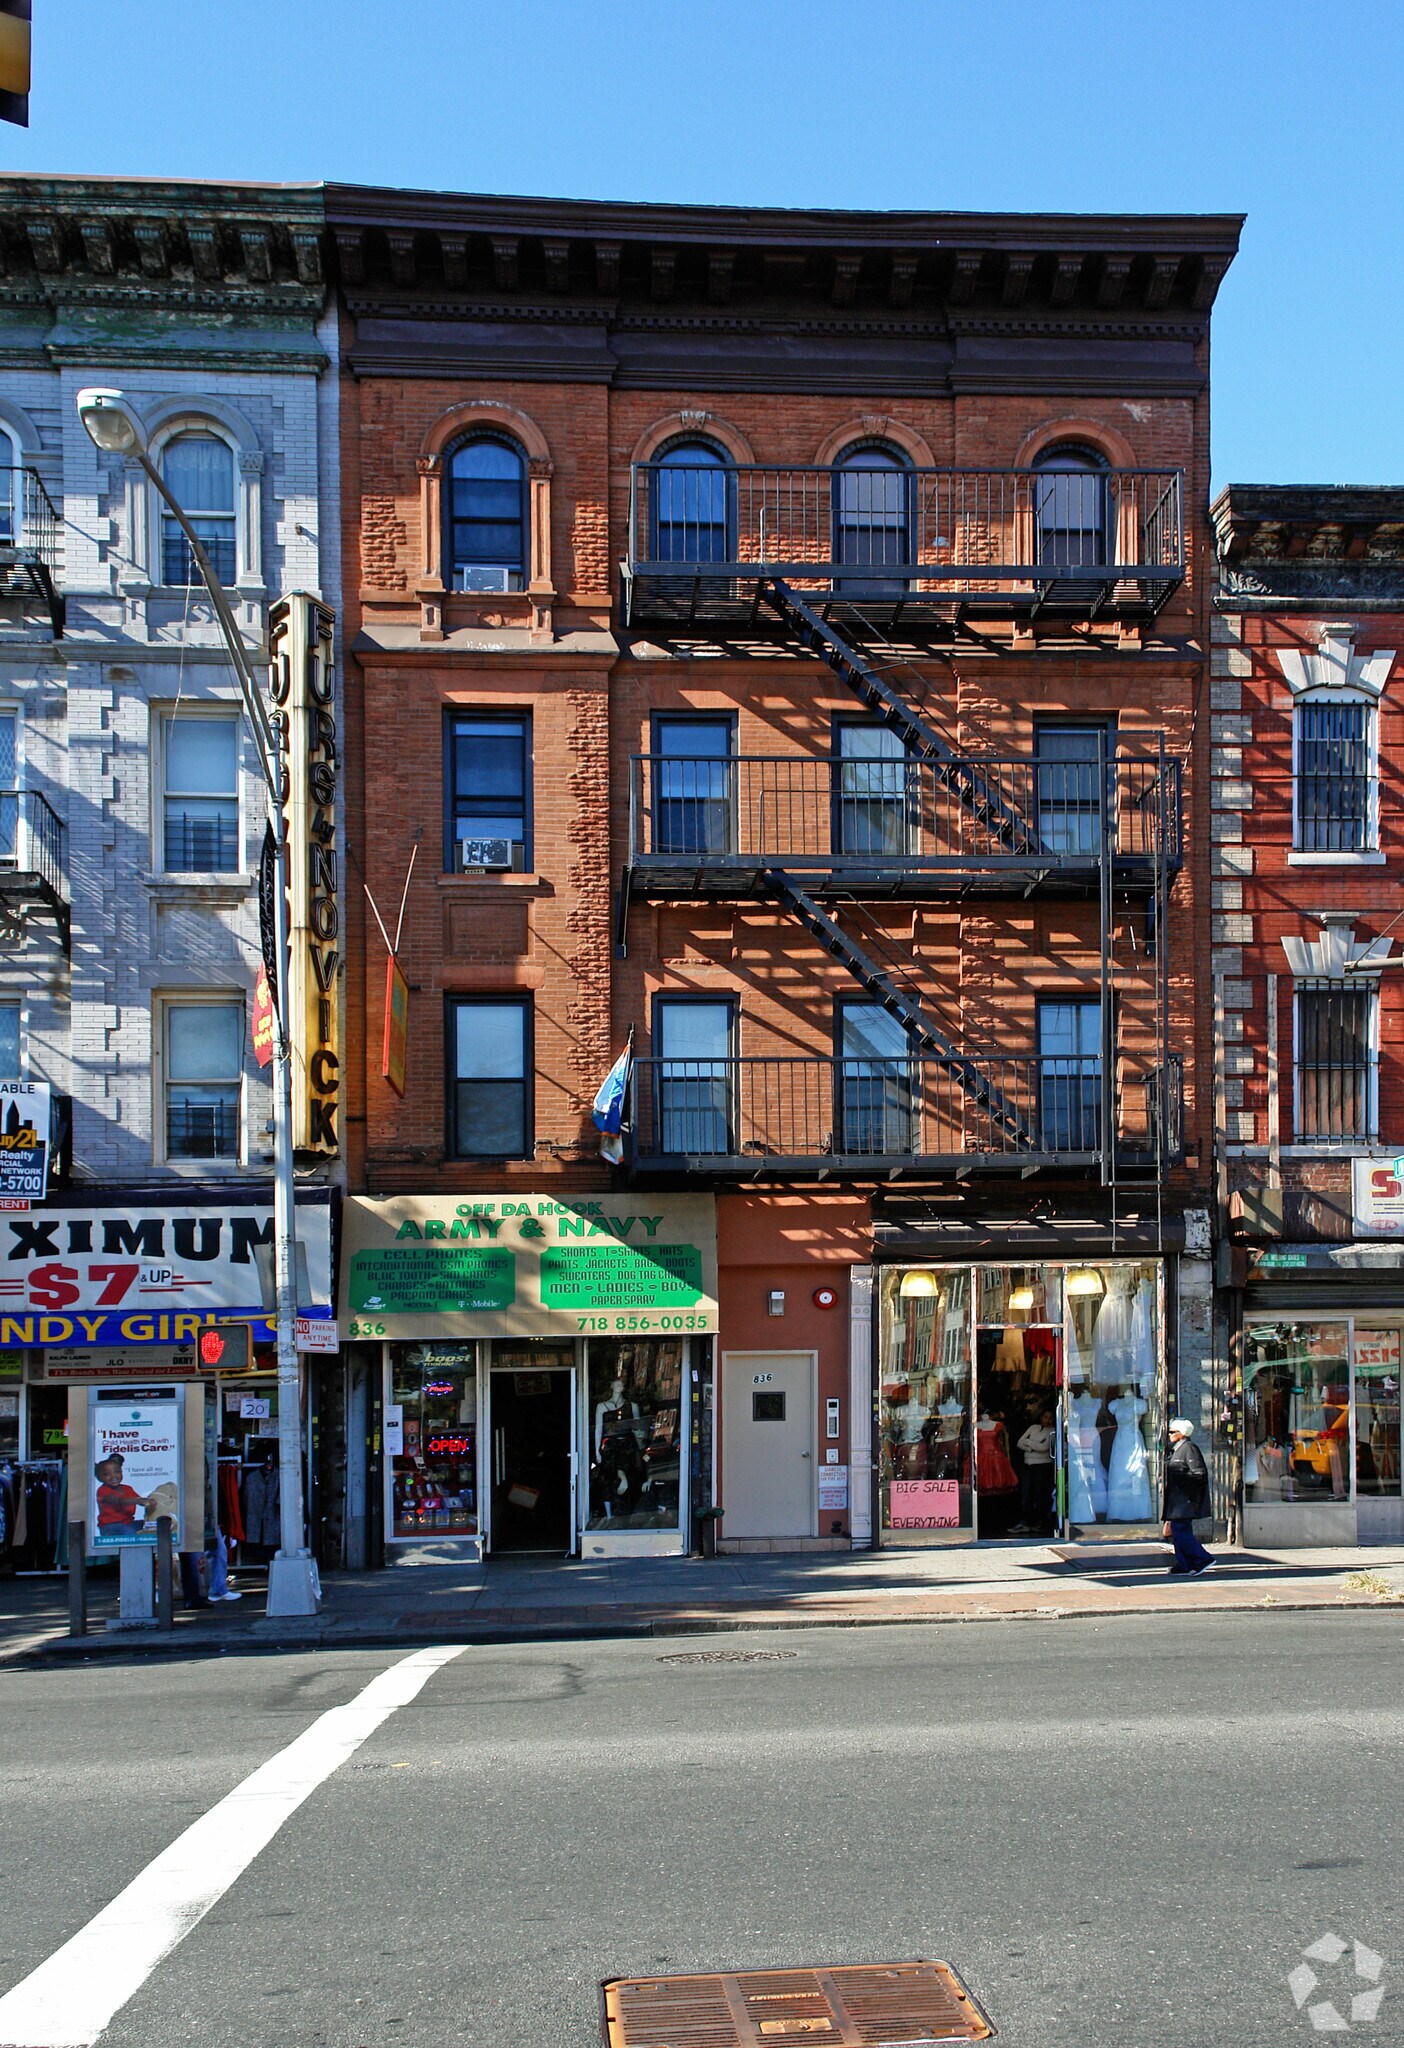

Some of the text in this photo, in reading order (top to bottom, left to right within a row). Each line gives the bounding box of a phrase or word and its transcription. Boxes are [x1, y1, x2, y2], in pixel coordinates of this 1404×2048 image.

[308, 602, 336, 806] FURS
[309, 842, 339, 1147] NOVICK
[1, 1150, 34, 1162] Realty
[456, 1202, 604, 1217] OFF DA HOOK
[395, 1216, 664, 1240] ARMY & NAVY
[384, 1249, 482, 1260] CELL PHONES
[560, 1246, 683, 1258] SHORTS T-SHIRTS HATS
[356, 1259, 509, 1271] INTERNATIONAL GSM PHONES
[547, 1257, 695, 1270] PANTS JACKETS BAGS BOOTS
[367, 1271, 395, 1281] BLUE
[462, 1270, 497, 1279] CARDS
[559, 1269, 686, 1281] SWEATERS DOG TAG CHAIN
[28, 1263, 139, 1310] $7
[150, 1270, 171, 1283] UP
[550, 1282, 695, 1293] MEN LADIES BOYS
[391, 1290, 473, 1301] PREPAID CARDS
[591, 1295, 656, 1305] PAPER SPRAY
[1, 1315, 108, 1343] NDY
[296, 1321, 335, 1333] NO PARKING
[349, 1316, 708, 1336] 836 718 856-0035
[106, 1359, 124, 1367] JLO
[172, 1356, 193, 1366] DKNY
[425, 1351, 470, 1362] boost
[753, 1374, 772, 1384] 836
[245, 1404, 265, 1415] 20
[109, 1430, 139, 1439] have
[102, 1445, 139, 1453] Fidelis
[430, 1439, 467, 1452] OPEN
[896, 1481, 957, 1493] BIG SALE
[892, 1516, 958, 1528] EVERYTHING
